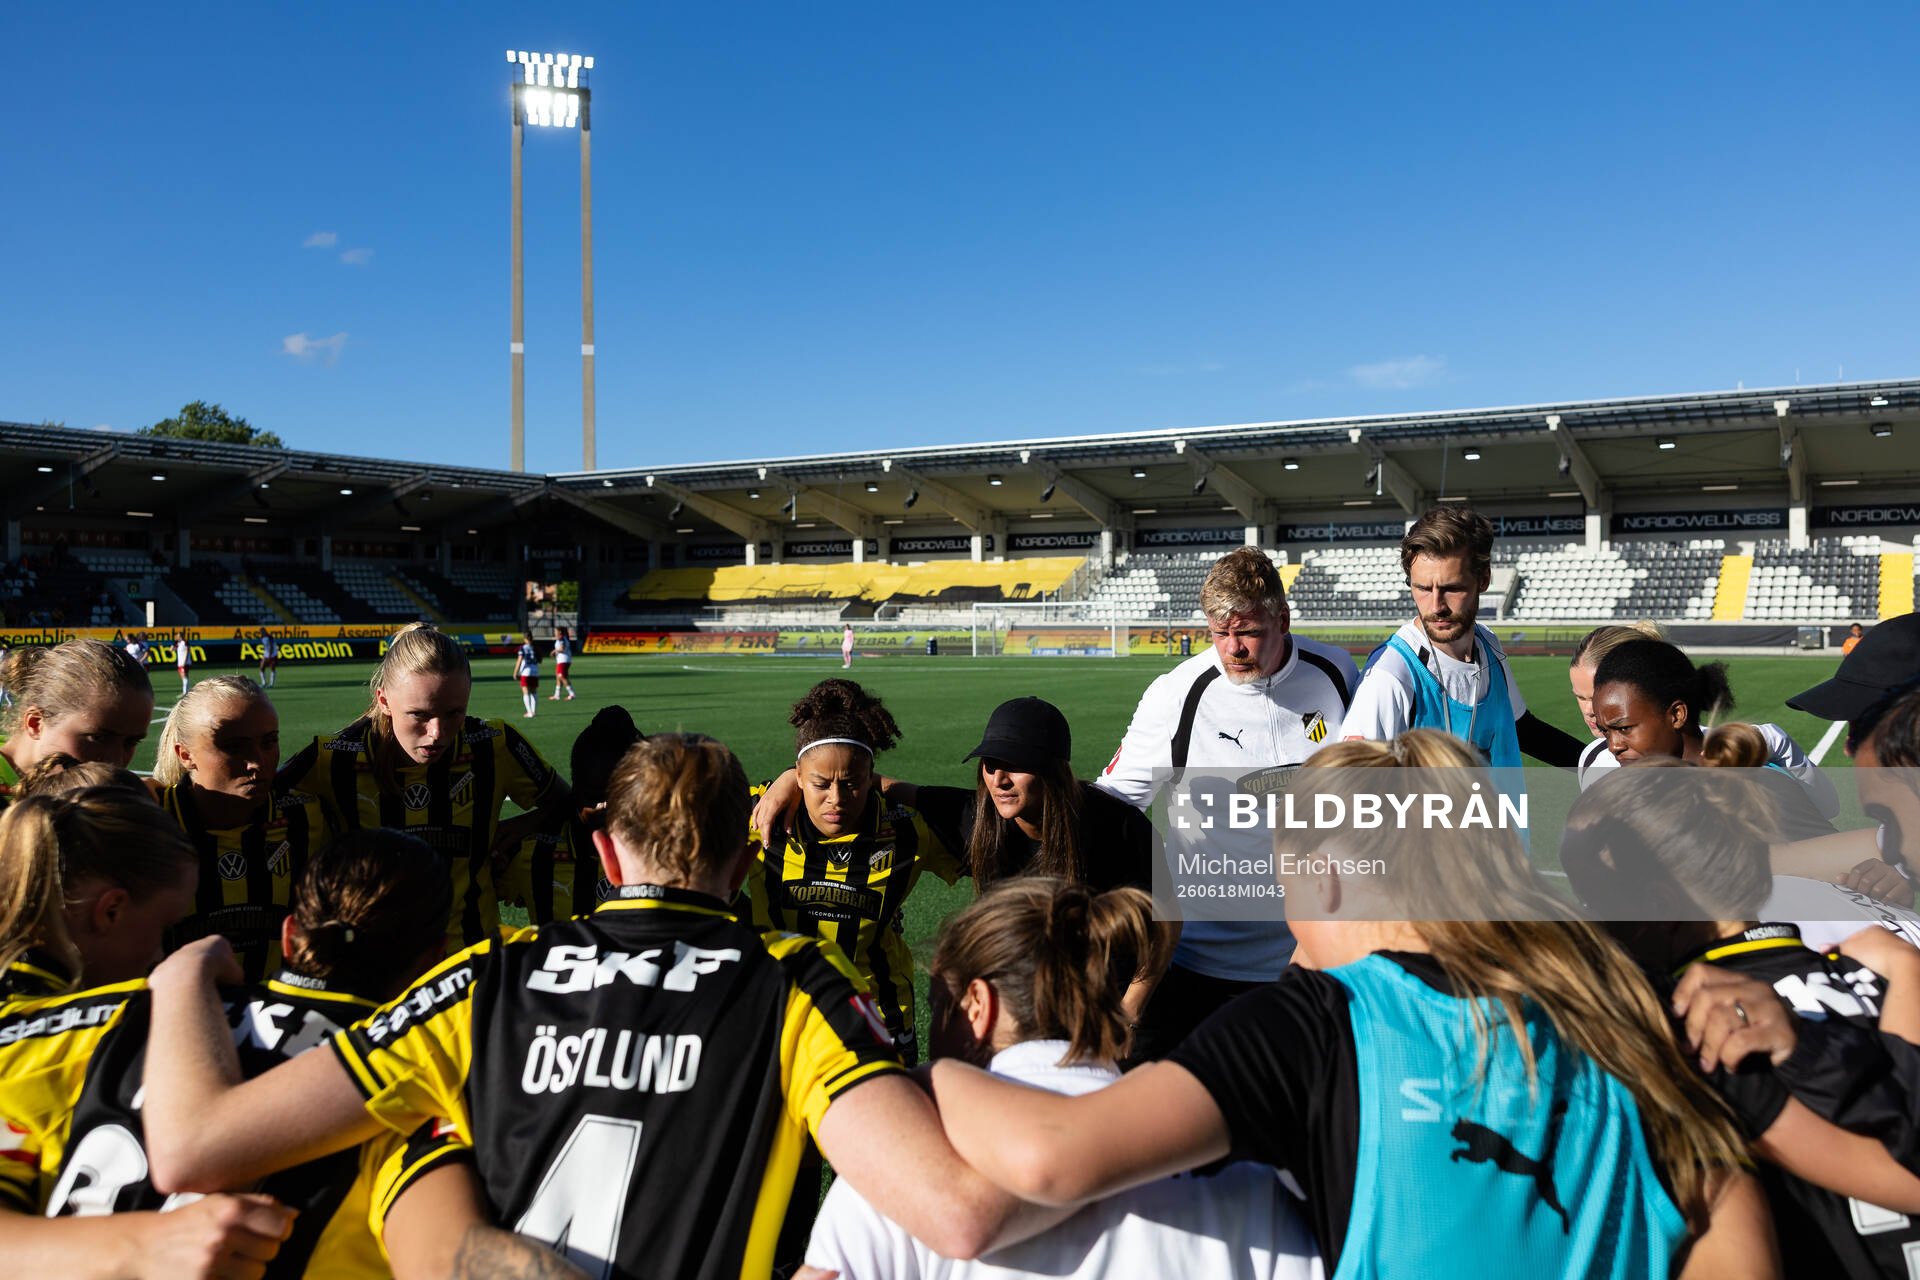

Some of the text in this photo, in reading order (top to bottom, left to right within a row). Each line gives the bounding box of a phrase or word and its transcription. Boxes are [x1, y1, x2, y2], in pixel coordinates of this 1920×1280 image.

[1143, 529, 1245, 543] NORDICWELLNES
[1288, 525, 1405, 539] NORDICWELLNES
[233, 626, 310, 639] Assmblin
[240, 640, 354, 661] Asemblin
[526, 940, 741, 994] SKF
[521, 1025, 702, 1095] ÖSTLUND
